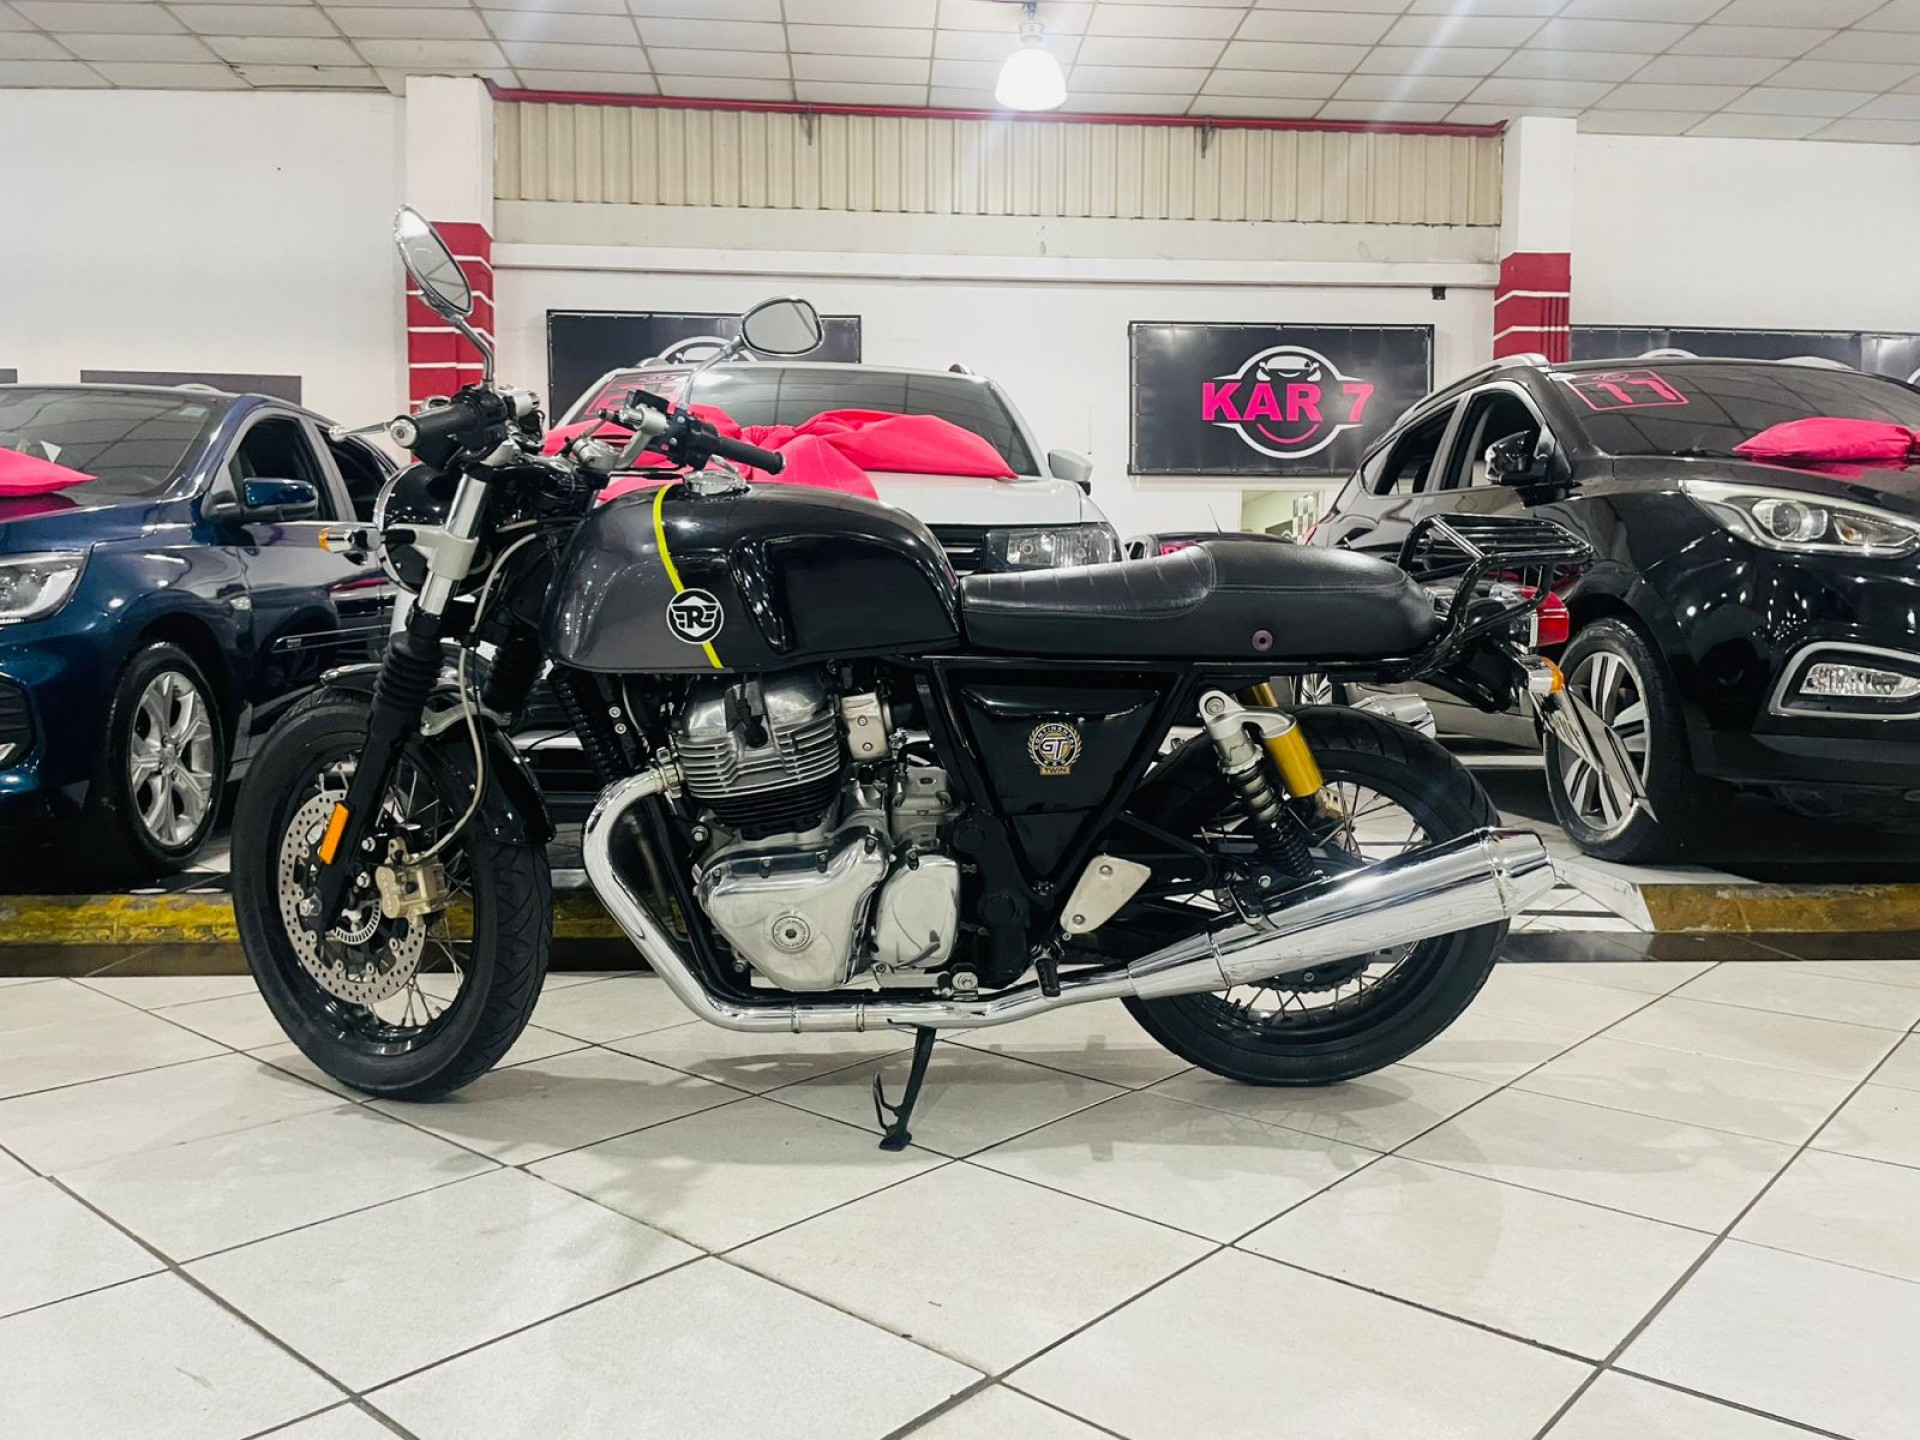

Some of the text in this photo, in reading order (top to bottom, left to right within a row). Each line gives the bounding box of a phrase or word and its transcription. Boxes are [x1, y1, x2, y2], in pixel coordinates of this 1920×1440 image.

[1202, 382, 1375, 422] KAR 7
[1041, 736, 1069, 761] GT
[1042, 766, 1068, 774] TWIN
